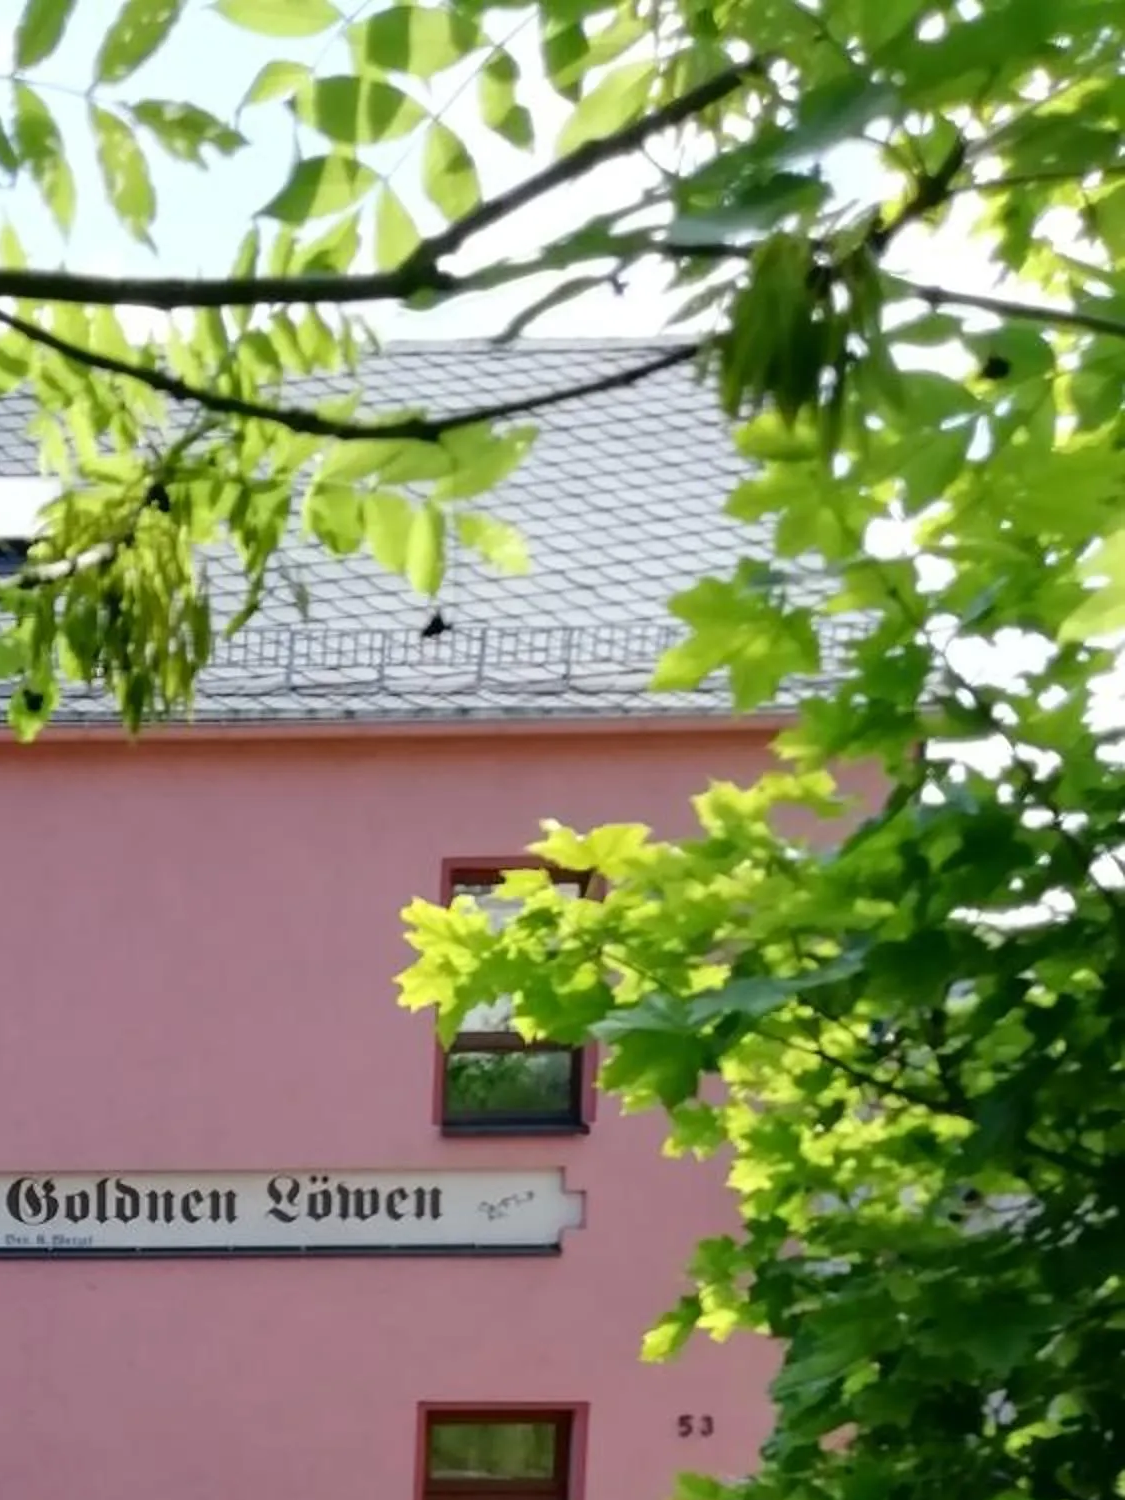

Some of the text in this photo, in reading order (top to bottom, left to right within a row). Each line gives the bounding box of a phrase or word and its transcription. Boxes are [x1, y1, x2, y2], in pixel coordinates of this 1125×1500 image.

[6, 1176, 239, 1226] Goldnen
[266, 1173, 443, 1224] Löwen
[677, 1413, 715, 1438] 53
